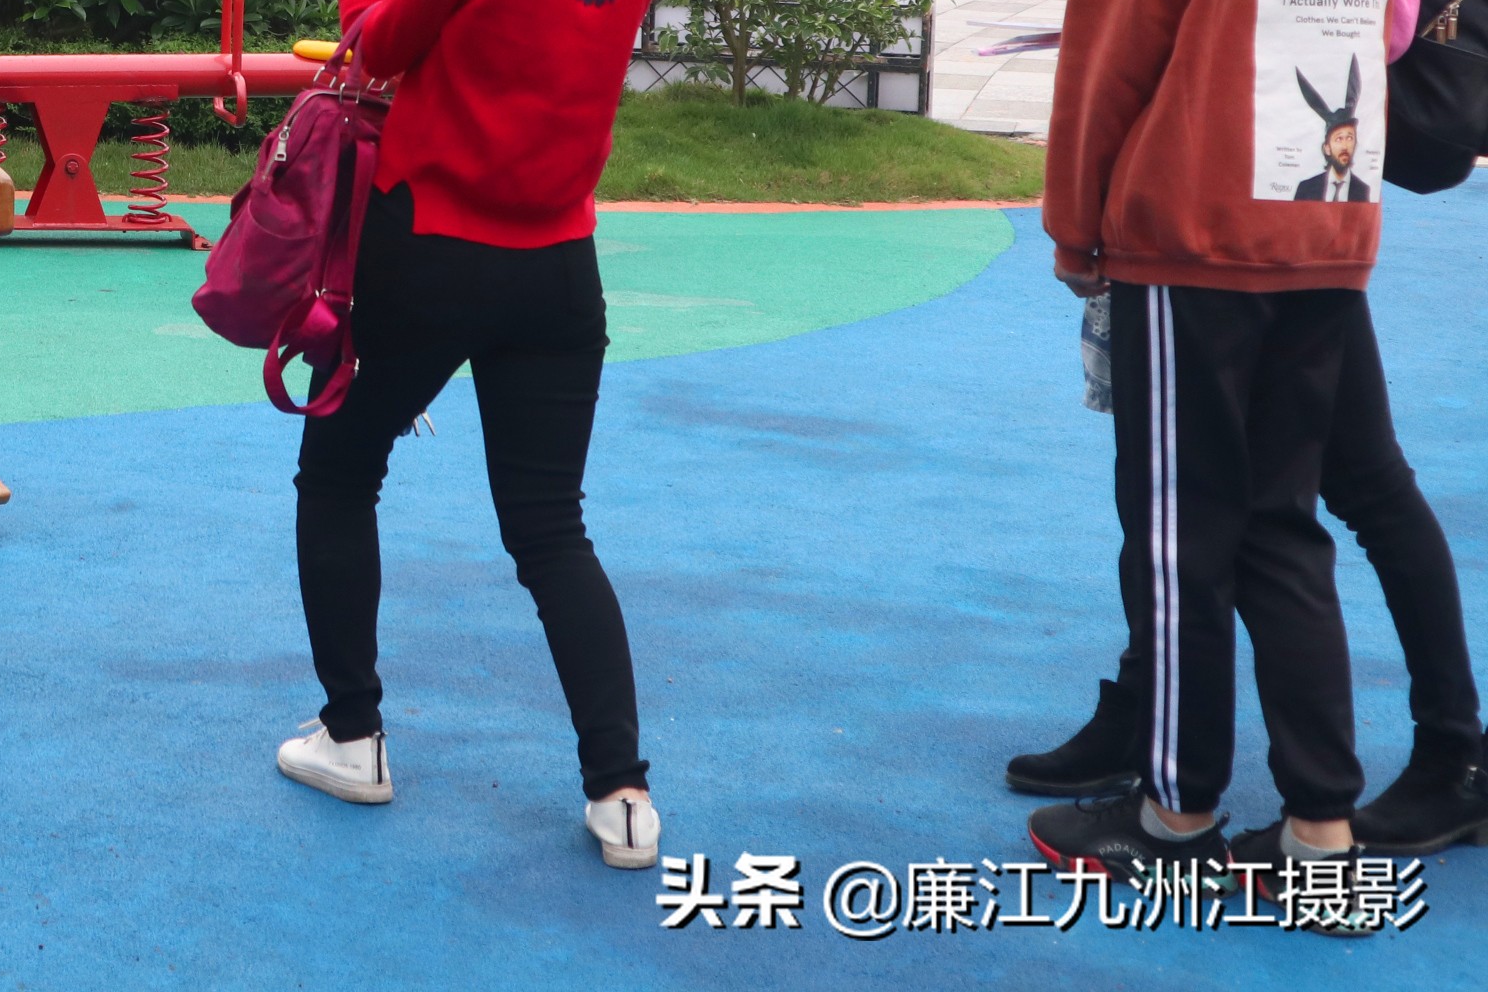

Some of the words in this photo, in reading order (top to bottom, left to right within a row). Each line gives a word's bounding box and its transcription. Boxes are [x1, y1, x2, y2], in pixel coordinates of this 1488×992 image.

[1295, 16, 1324, 24] Clothes
[1341, 17, 1359, 25] Can't
[1336, 30, 1360, 39] Bought
[1098, 843, 1146, 863] PADAUK
